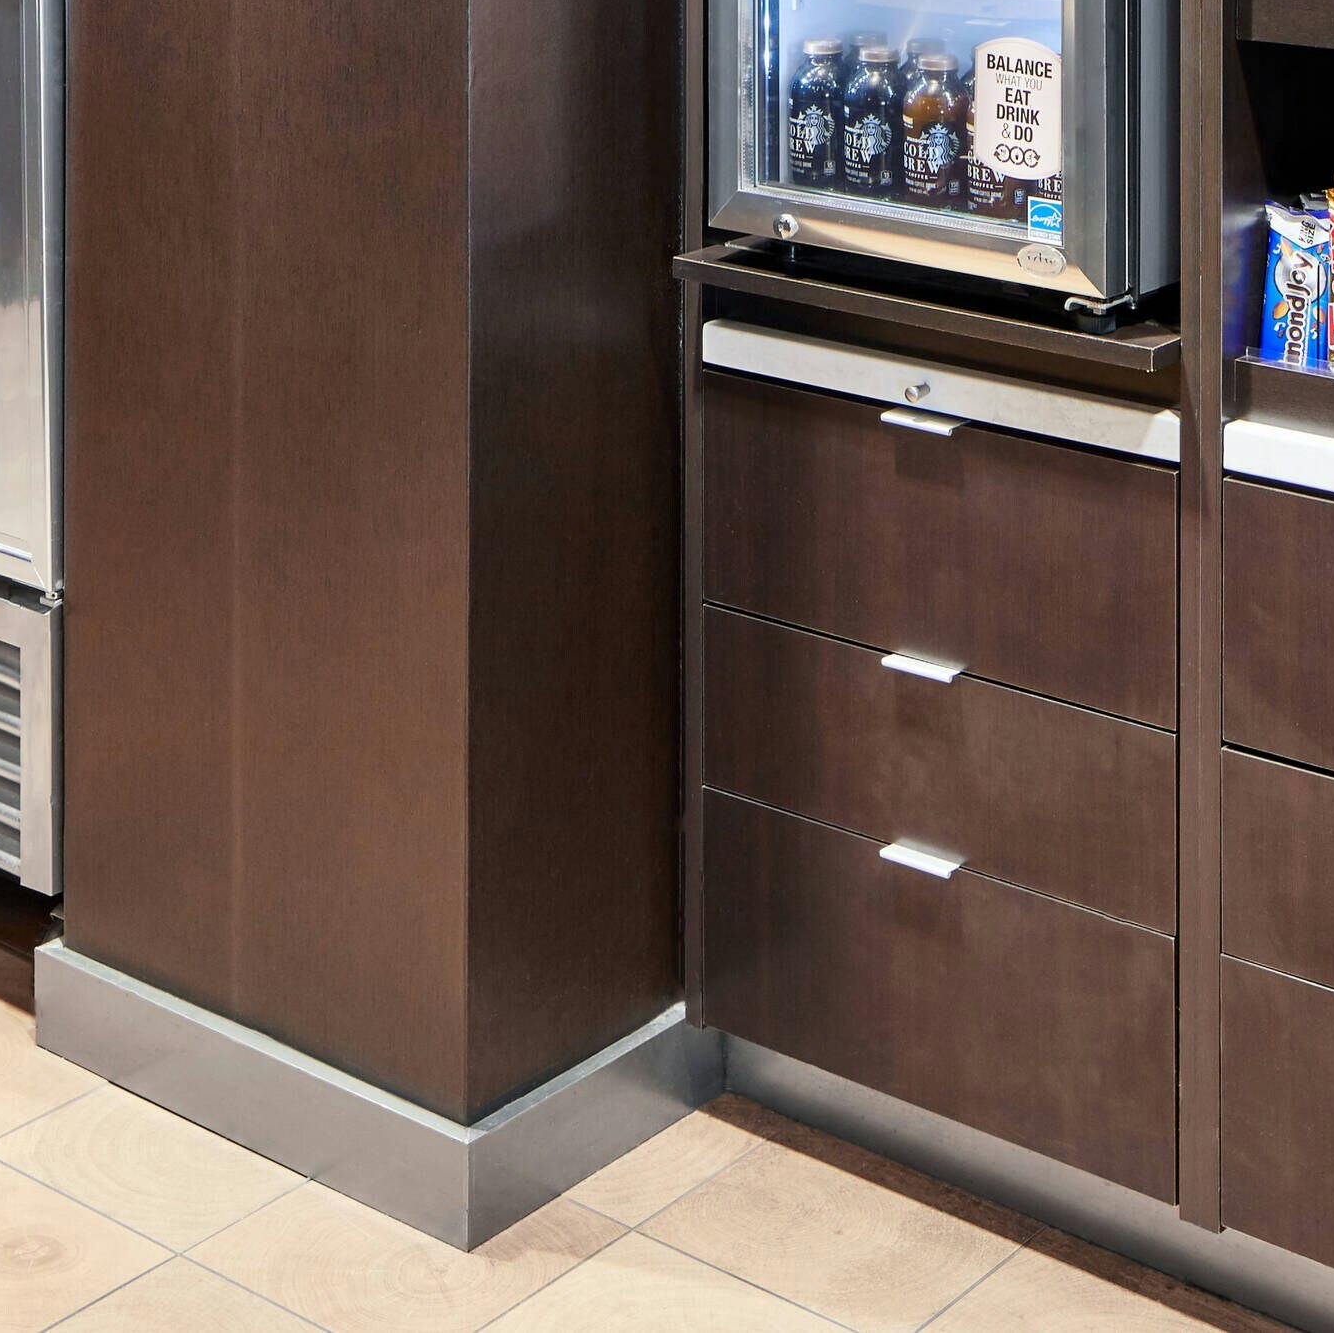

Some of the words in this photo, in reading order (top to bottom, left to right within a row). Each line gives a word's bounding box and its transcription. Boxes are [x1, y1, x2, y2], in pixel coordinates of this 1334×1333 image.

[986, 53, 1053, 79] BALANCE
[995, 72, 1019, 87] WHAT
[1023, 75, 1043, 91] YOU
[1005, 87, 1031, 106] EAT
[996, 104, 1040, 126] DRINK
[1001, 123, 1012, 139] &
[1014, 124, 1033, 144] DO
[904, 158, 940, 174] BREW
[968, 164, 1005, 183] BREW
[1038, 177, 1062, 193] BRE
